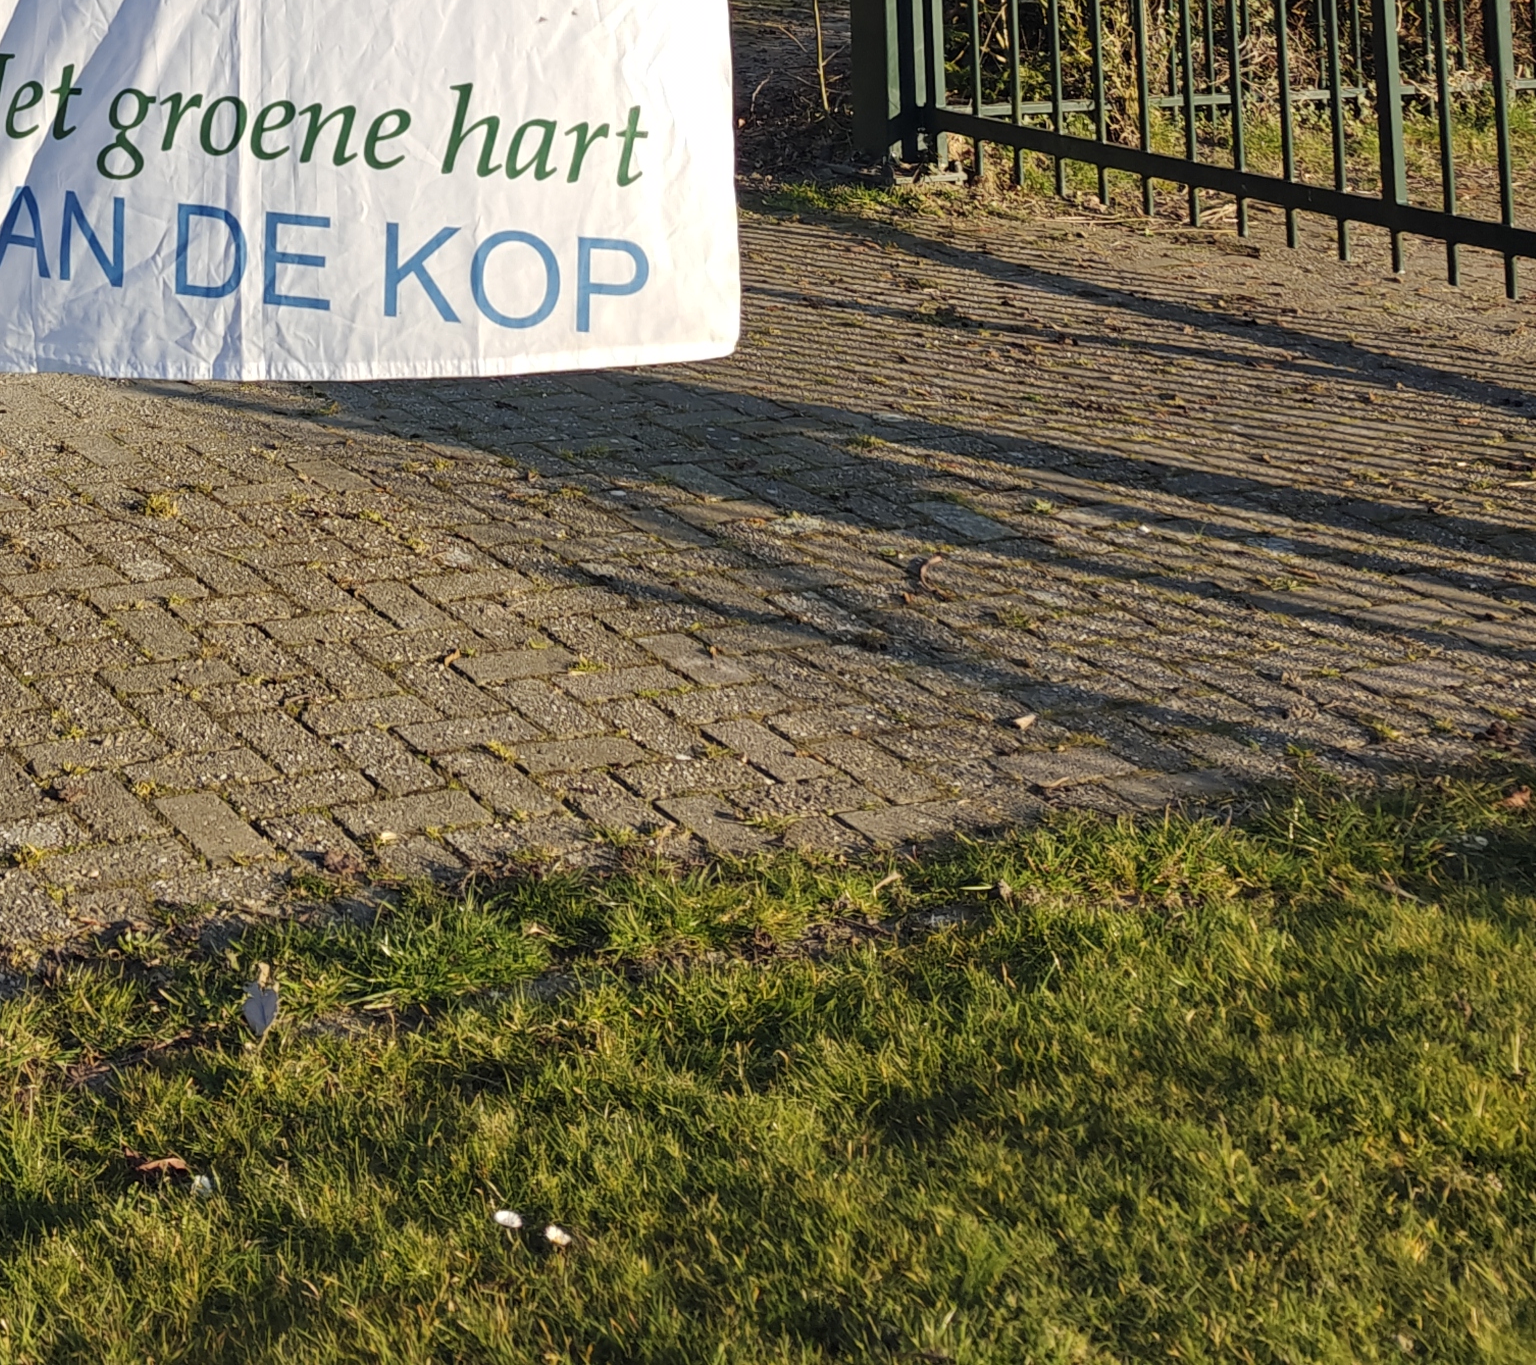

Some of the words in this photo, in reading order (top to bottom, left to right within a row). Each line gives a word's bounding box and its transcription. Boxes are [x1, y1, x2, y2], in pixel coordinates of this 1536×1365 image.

[95, 84, 412, 181] groene
[440, 82, 649, 188] hart
[174, 202, 332, 311] DE
[382, 221, 650, 333] KOP
